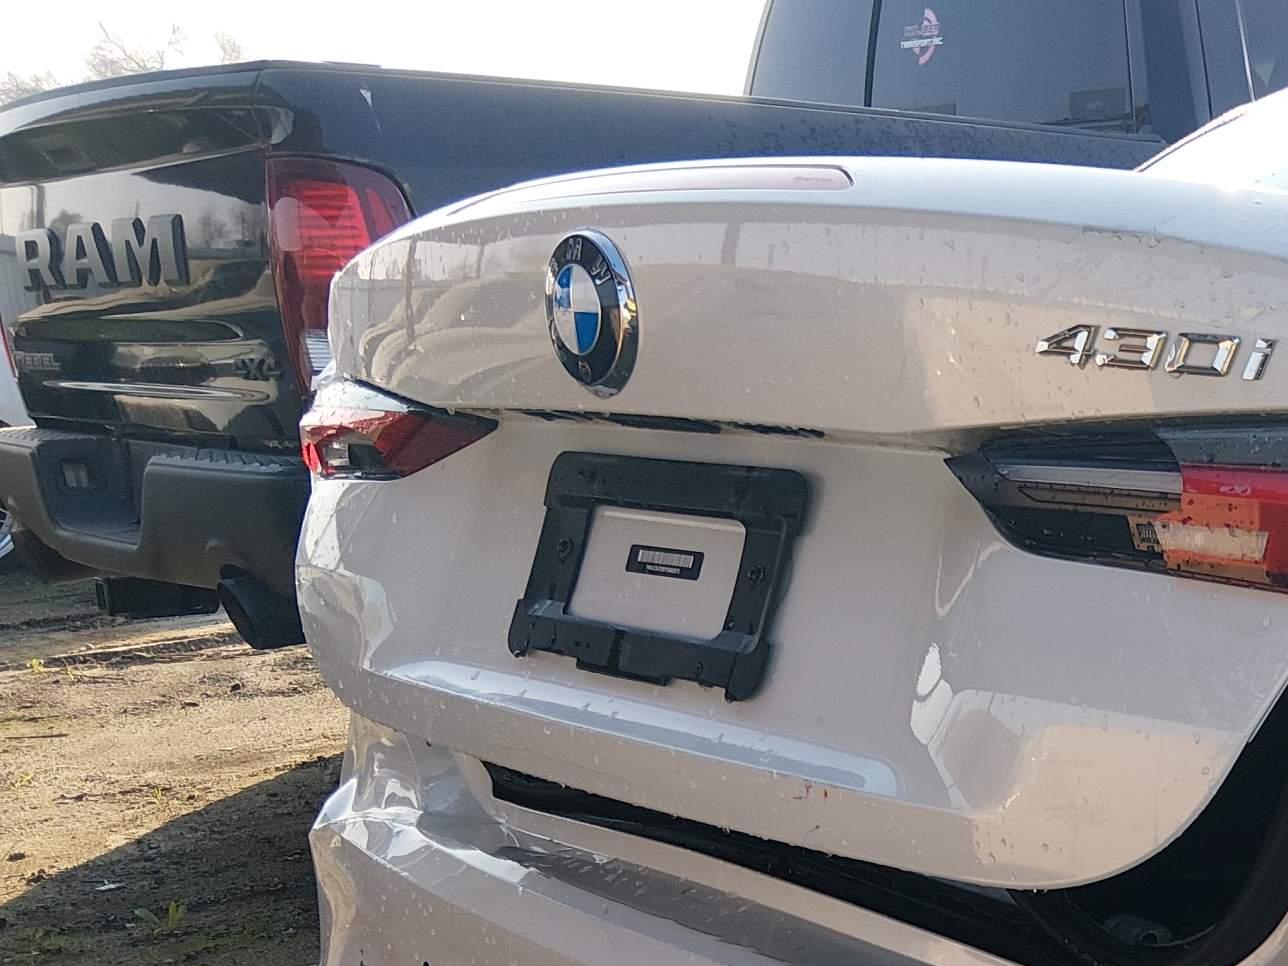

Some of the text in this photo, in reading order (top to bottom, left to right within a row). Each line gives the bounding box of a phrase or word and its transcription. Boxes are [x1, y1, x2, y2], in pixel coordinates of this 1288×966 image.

[16, 214, 190, 292] RAM
[14, 351, 62, 371] REBEL
[1035, 324, 1278, 381] 430i
